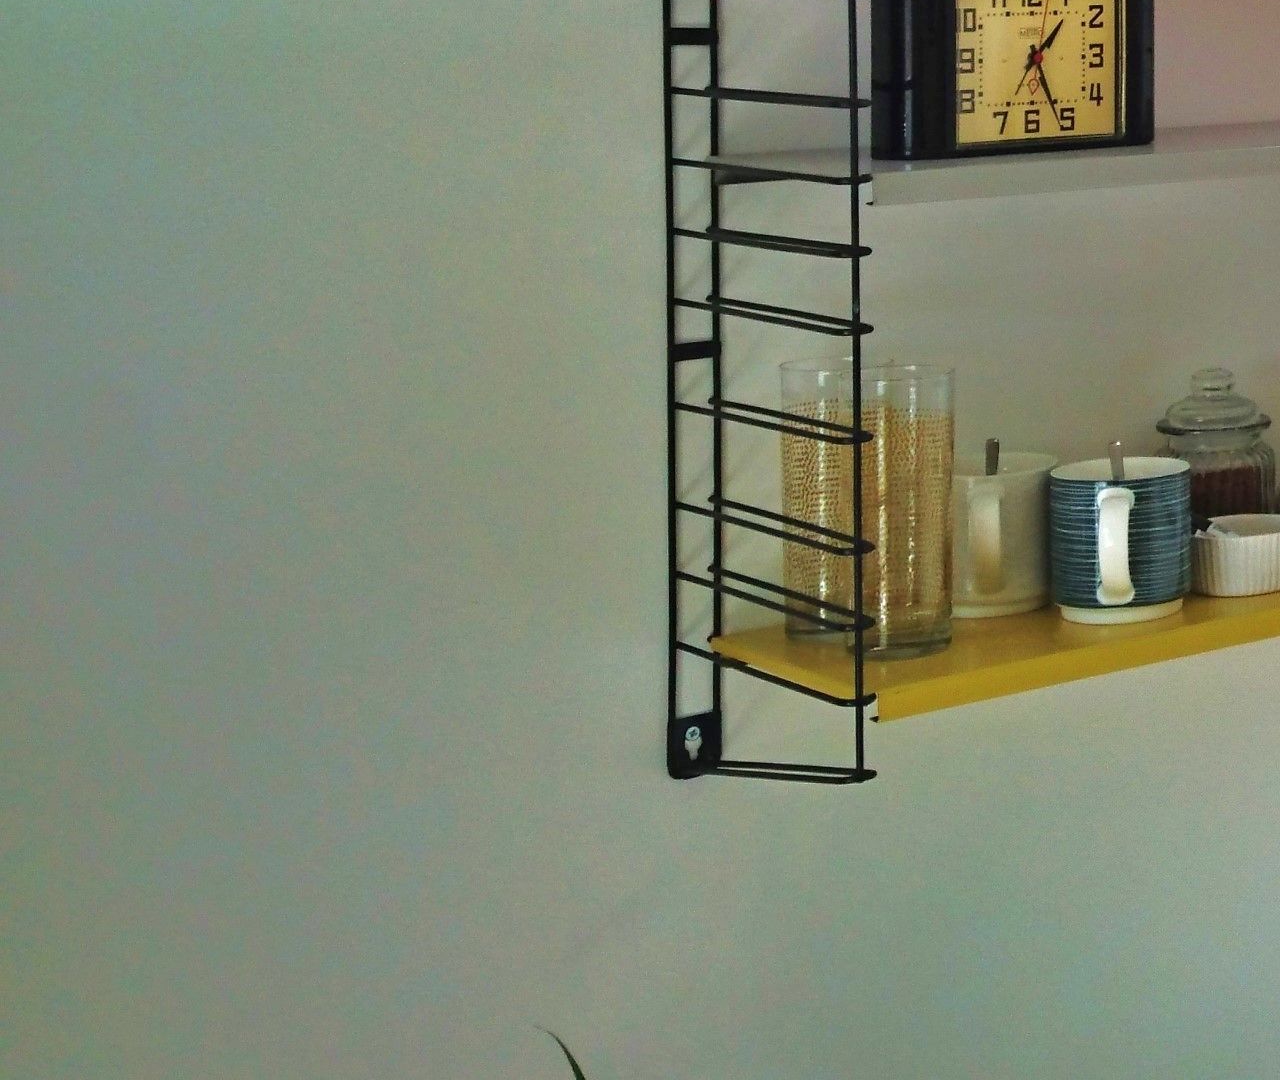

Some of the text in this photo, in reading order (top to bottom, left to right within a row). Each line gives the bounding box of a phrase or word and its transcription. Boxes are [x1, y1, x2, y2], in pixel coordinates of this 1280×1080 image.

[1088, 5, 1104, 29] 2
[958, 48, 975, 74] 9
[1088, 43, 1104, 68] 3
[958, 89, 975, 113] 8
[1088, 82, 1104, 107] 4
[993, 111, 1009, 135] 7
[1024, 109, 1040, 134] 6
[1059, 107, 1075, 132] 5
